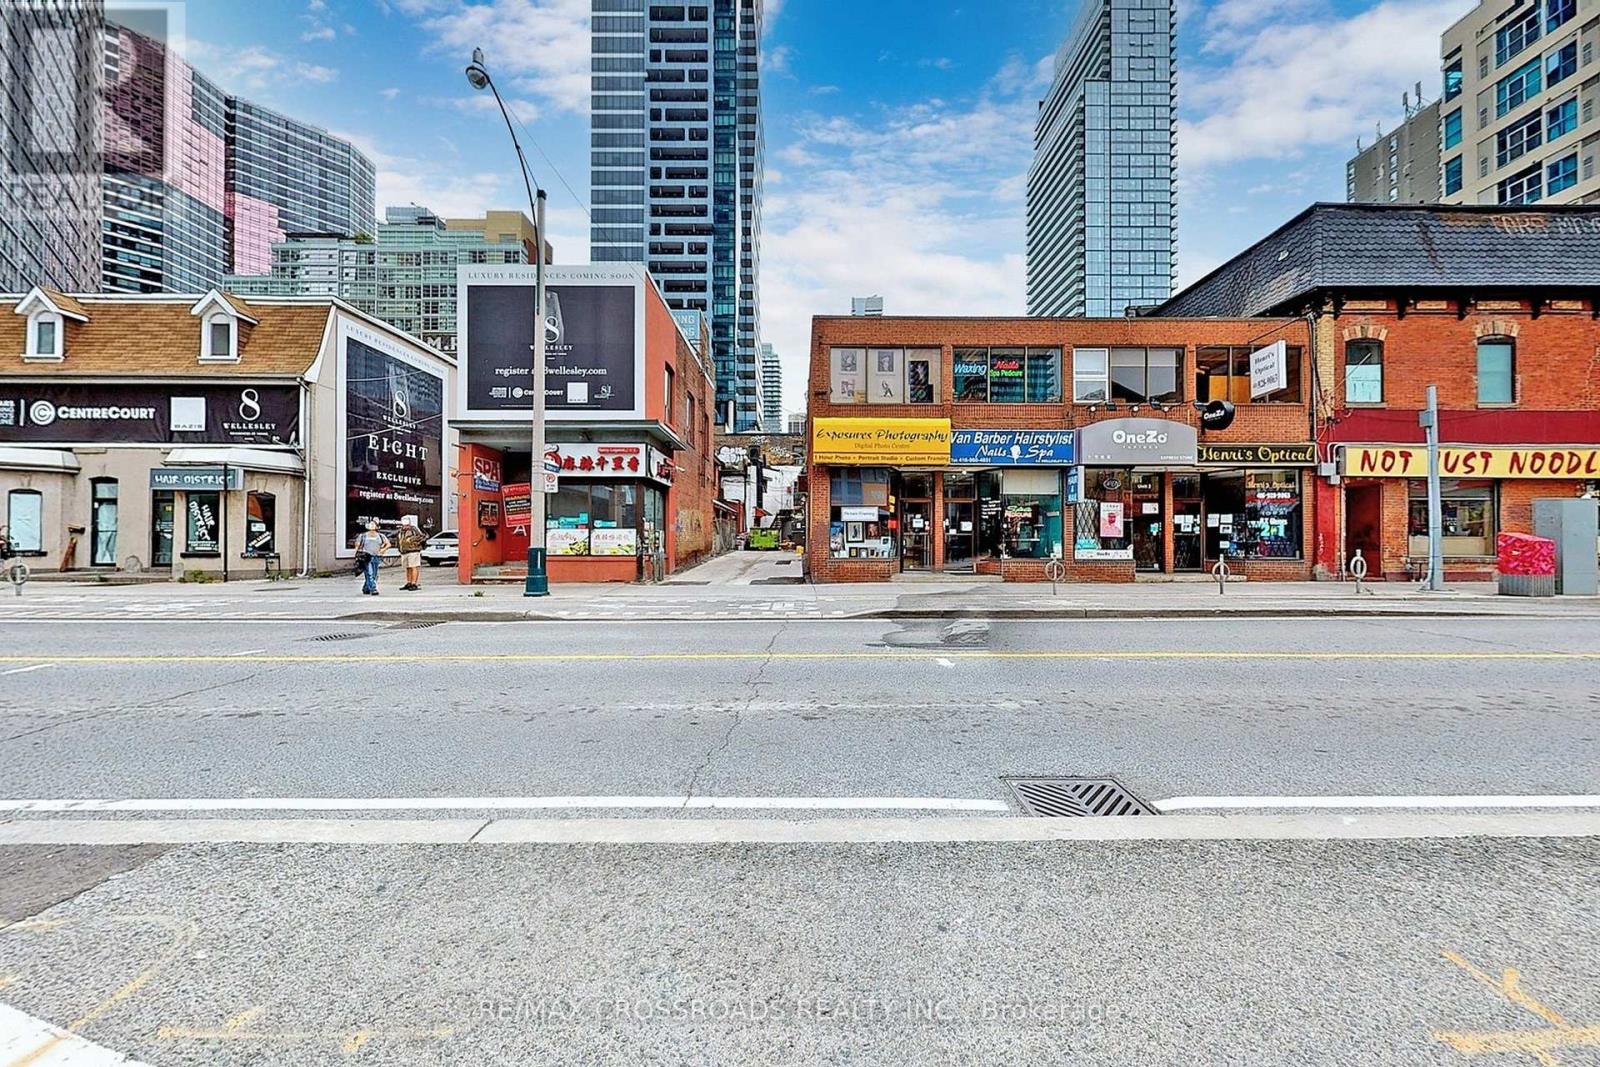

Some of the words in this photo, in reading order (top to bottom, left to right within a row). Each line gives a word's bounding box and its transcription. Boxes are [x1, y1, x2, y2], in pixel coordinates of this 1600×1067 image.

[544, 315, 559, 343] 8
[495, 366, 529, 377] register
[544, 366, 607, 377] 8wellesley.com
[955, 364, 987, 376] Waxing
[990, 369, 1000, 377] Spa
[994, 361, 1019, 370] Nails
[1255, 361, 1275, 375] Optical
[240, 388, 260, 421] 8
[393, 391, 406, 417] 8
[383, 415, 417, 430] WELLESLEY
[816, 428, 872, 441] Exposures
[876, 428, 948, 443] Photography
[951, 432, 970, 444] Van
[973, 432, 1011, 444] Barber
[1014, 432, 1073, 447] Hairstylist
[1112, 430, 1167, 444] OneZo
[368, 434, 428, 460] EIGHT
[975, 445, 1006, 458] Nails
[1025, 445, 1053, 460] Spa
[1197, 446, 1253, 461] Henri's
[1258, 446, 1314, 463] Optical
[396, 461, 404, 469] IS
[475, 458, 499, 481] SPA
[1360, 450, 1413, 473] NOT
[1437, 451, 1493, 474] UST
[1509, 451, 1600, 474] NOODL
[155, 475, 179, 483] HAIR
[376, 472, 421, 485] EXCLUSIVE
[360, 490, 385, 500] register
[189, 501, 211, 540] DISTRICT
[201, 504, 215, 530] HAIR
